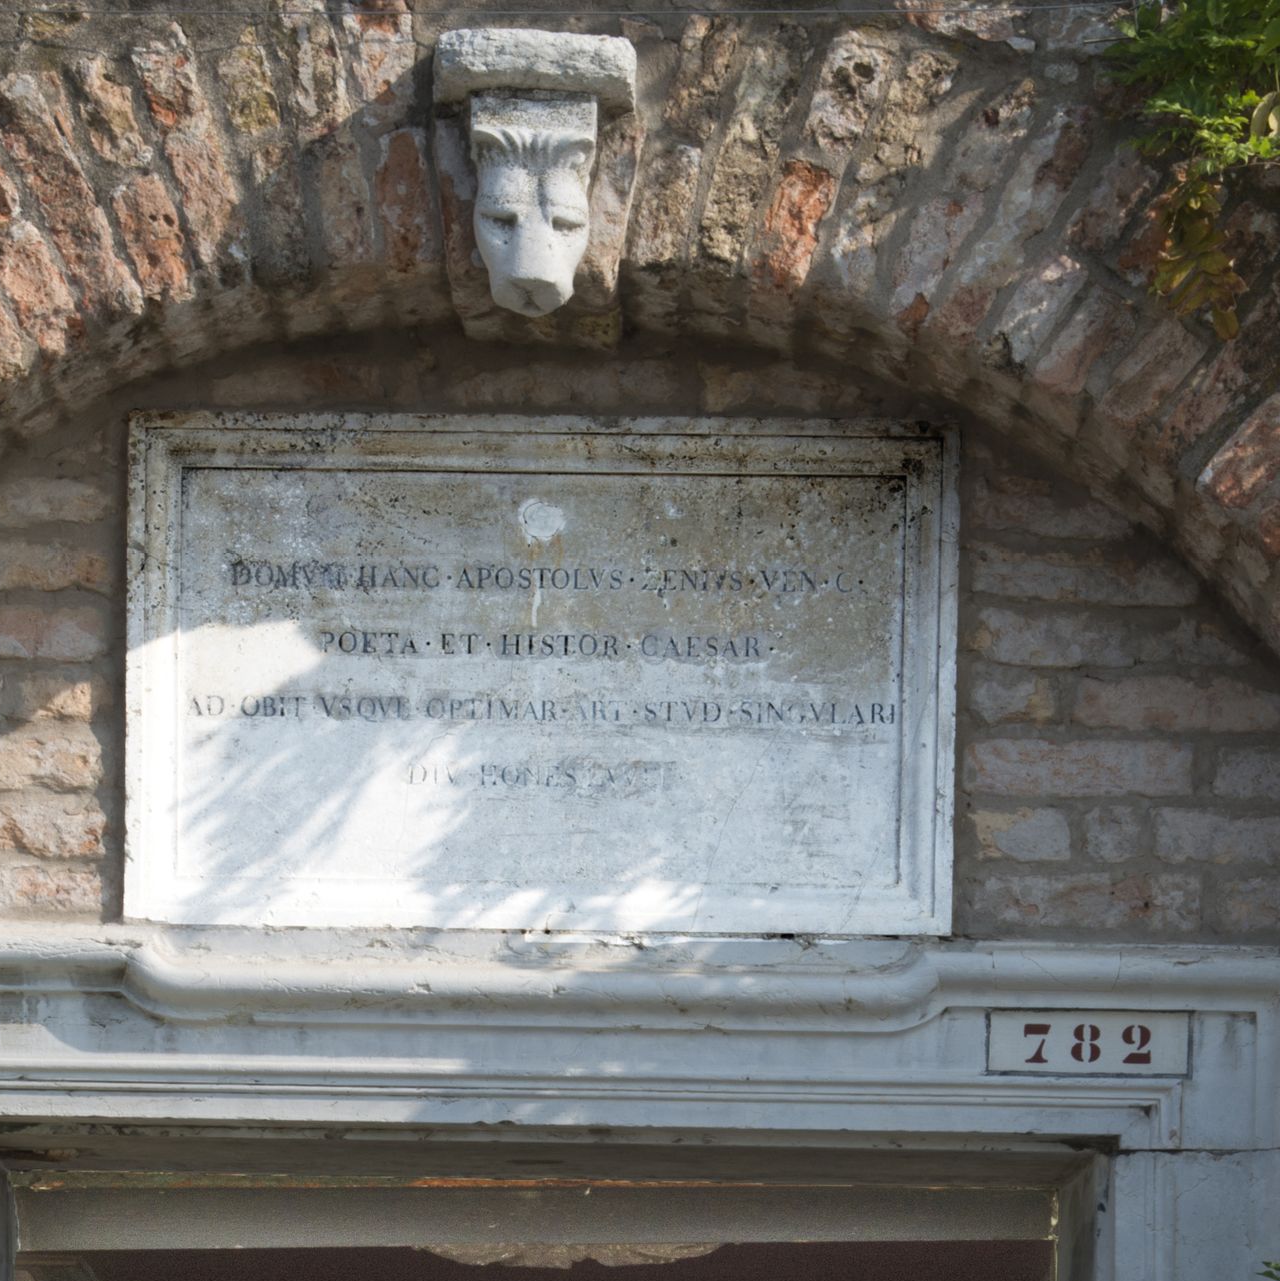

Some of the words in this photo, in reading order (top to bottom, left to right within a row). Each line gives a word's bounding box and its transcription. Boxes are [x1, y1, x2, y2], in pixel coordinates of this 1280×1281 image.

[358, 564, 440, 589] HANC
[455, 566, 622, 590] APOSTOLVS
[320, 630, 417, 654] POETA
[441, 632, 481, 655] ET
[501, 633, 618, 657] HISTOR
[641, 635, 761, 658] CAESAR
[188, 695, 225, 717] AD
[240, 695, 307, 718] OBIT
[643, 701, 721, 723] STVD
[1023, 1022, 1152, 1065] 782
